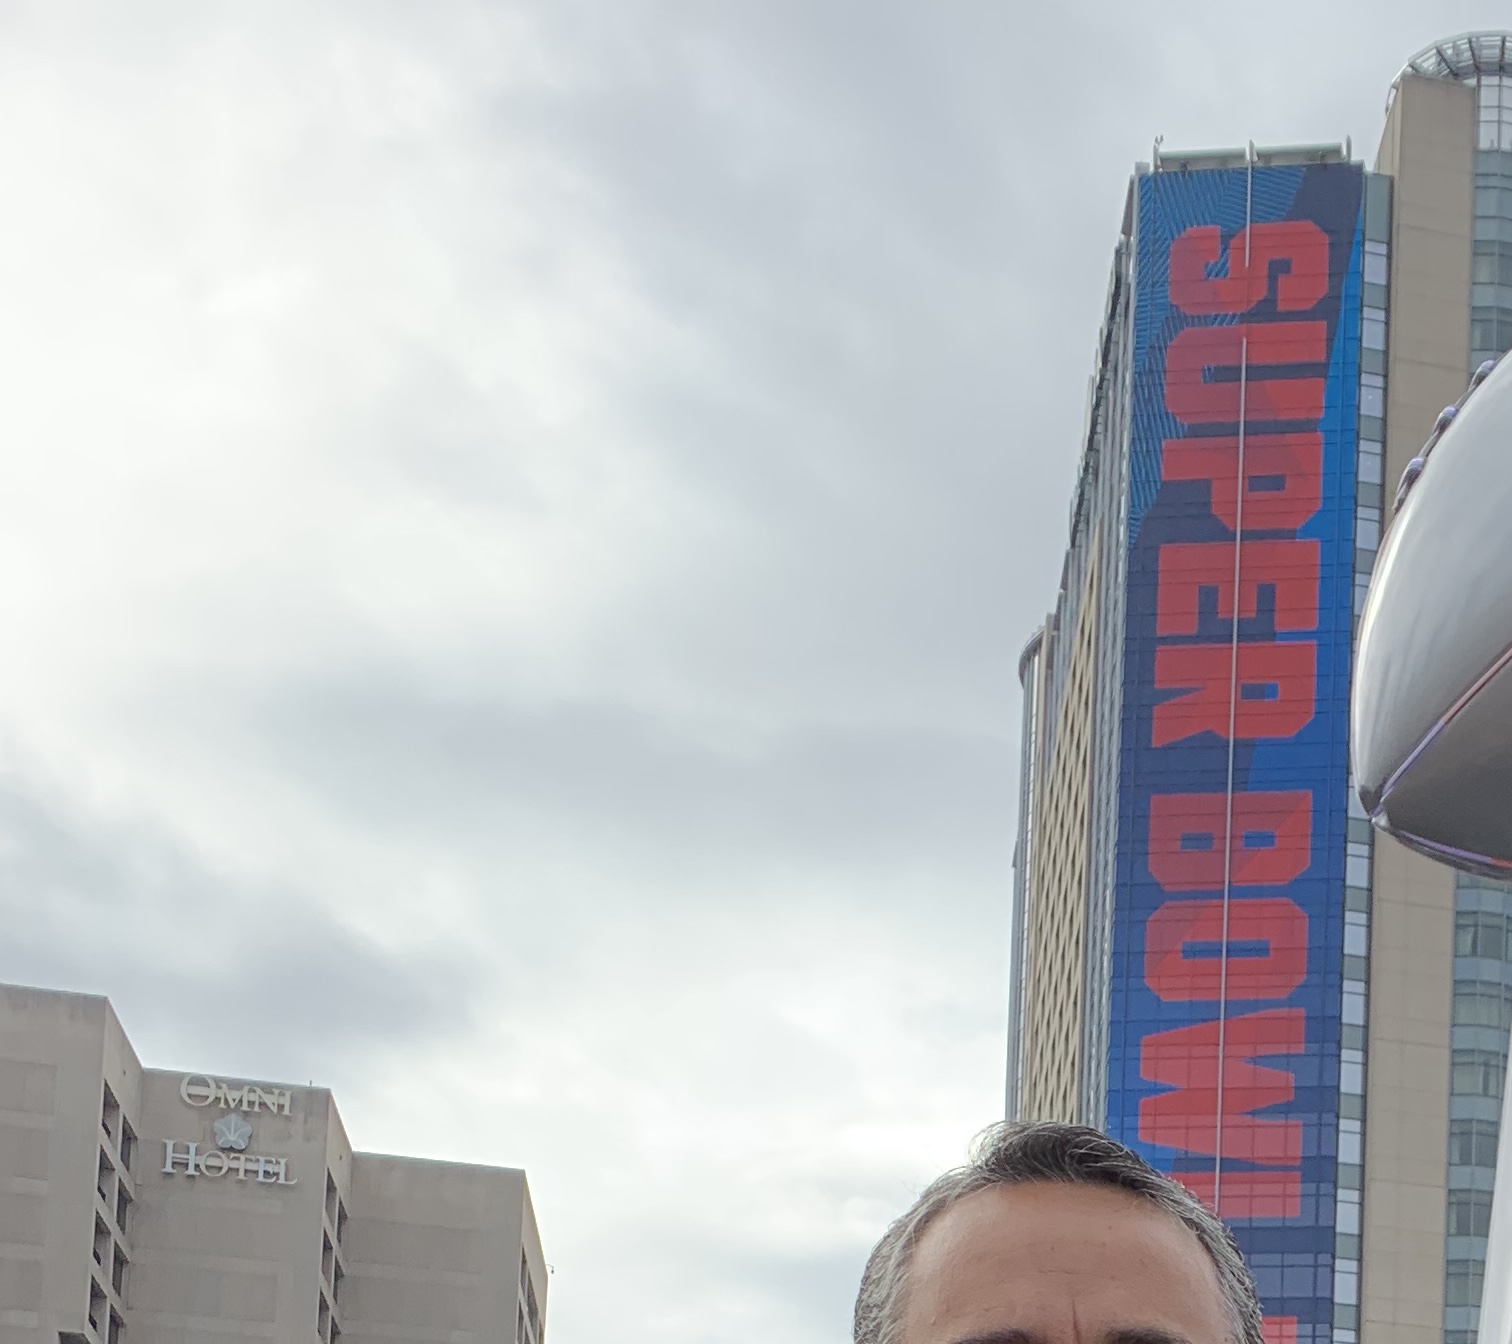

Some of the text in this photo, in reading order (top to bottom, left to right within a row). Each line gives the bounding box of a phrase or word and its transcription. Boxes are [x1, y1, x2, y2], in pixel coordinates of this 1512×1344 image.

[1152, 220, 1330, 749] SUPER
[180, 1073, 294, 1115] OMNI
[161, 1139, 297, 1185] HOTEL
